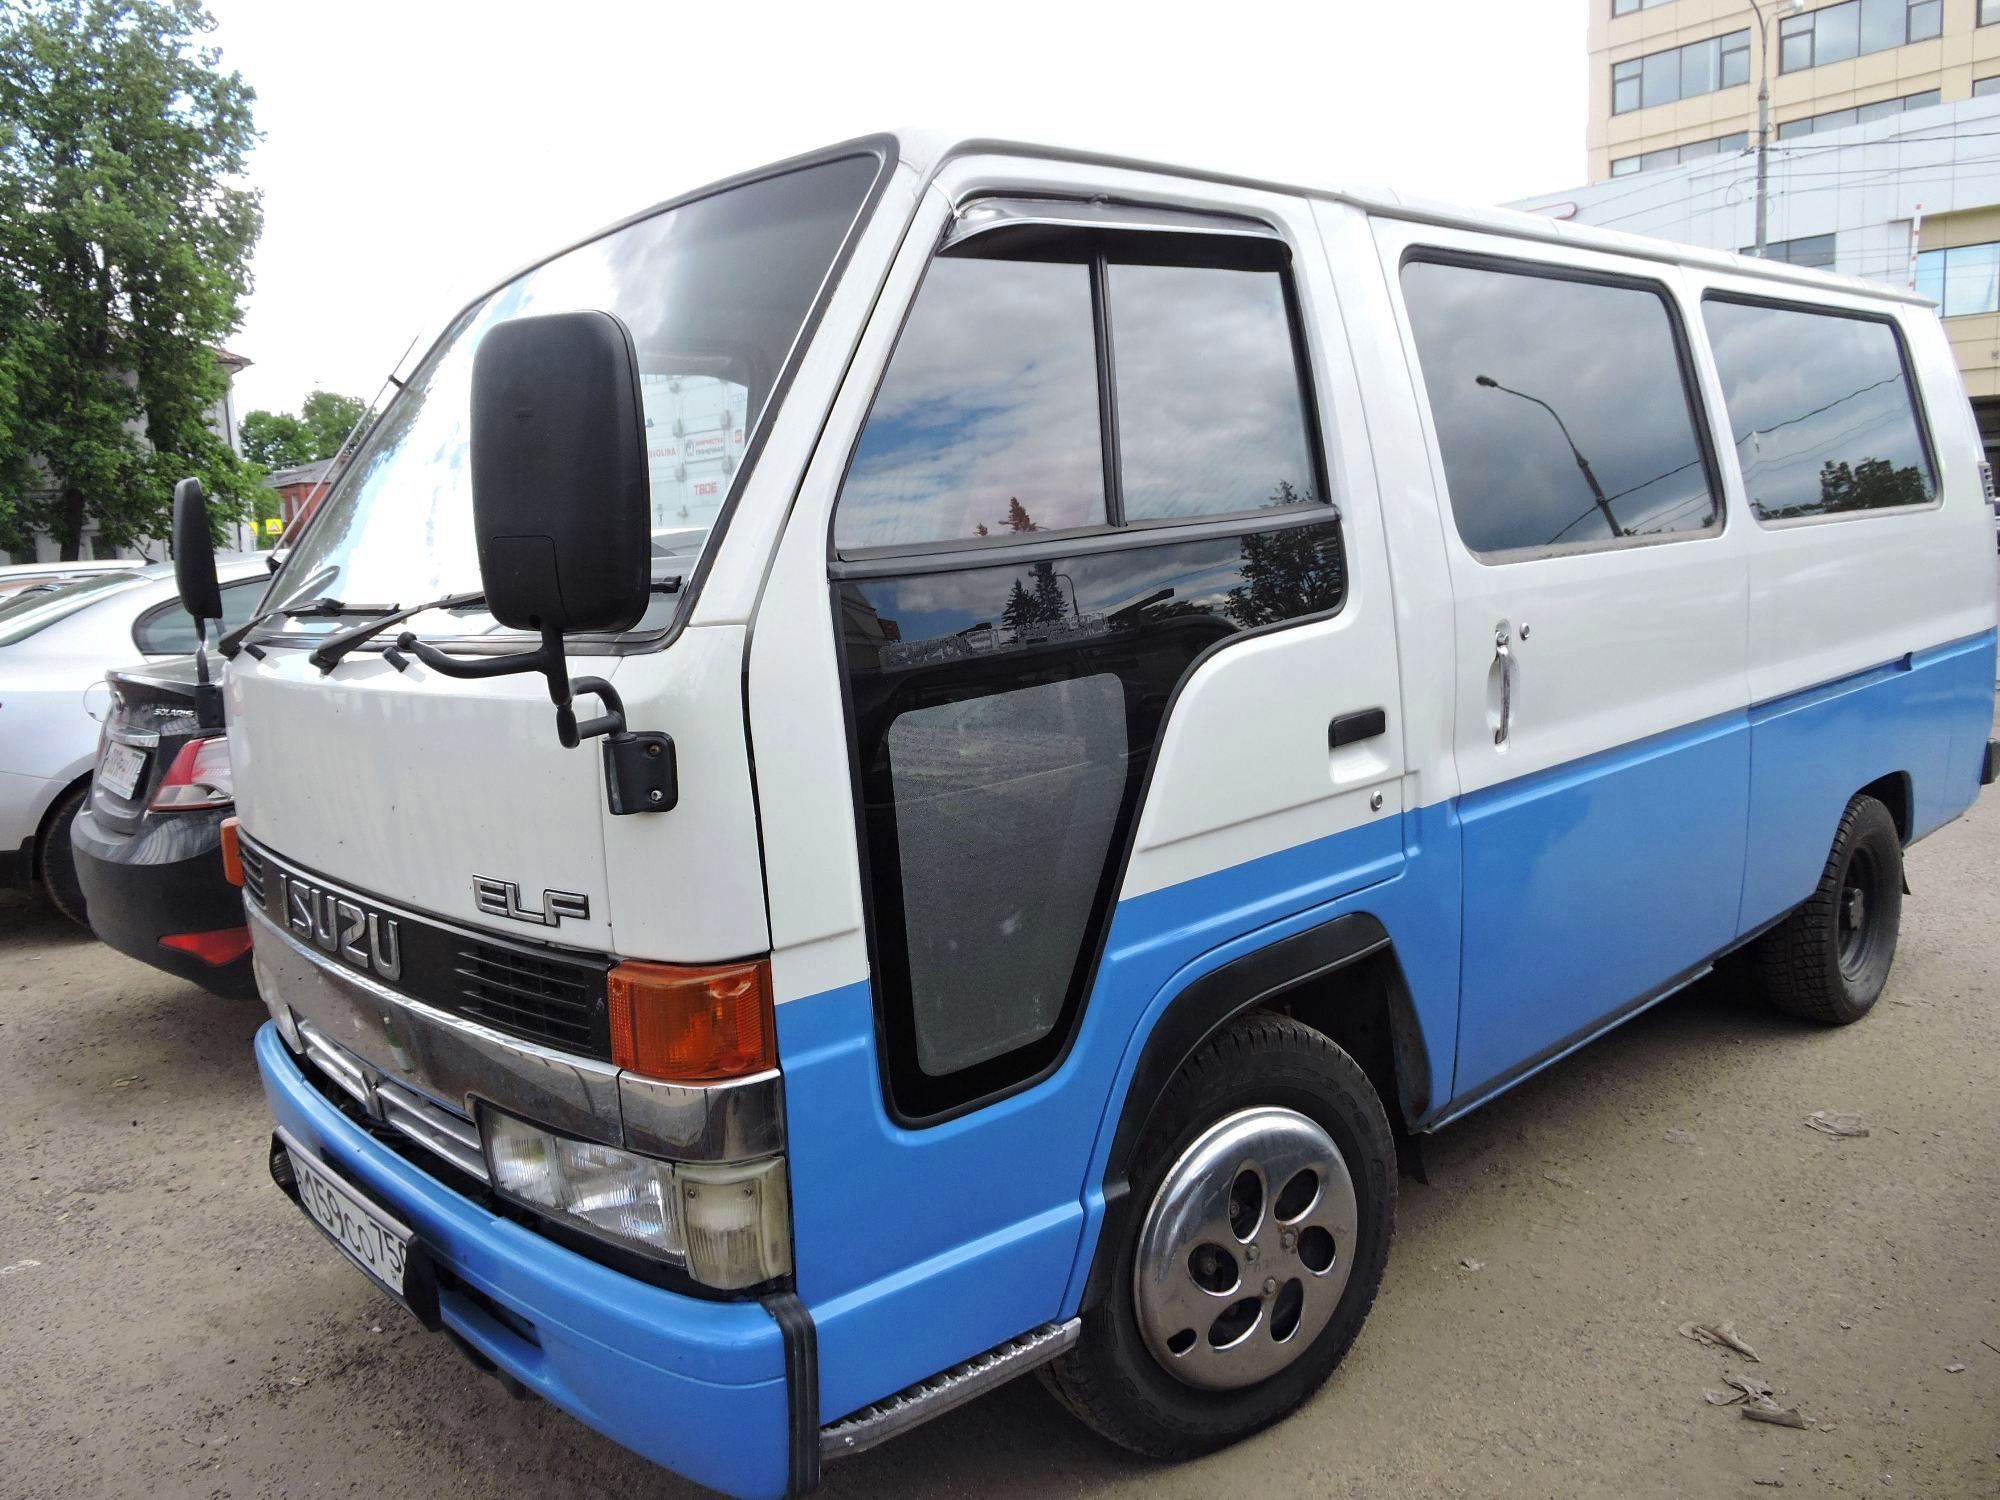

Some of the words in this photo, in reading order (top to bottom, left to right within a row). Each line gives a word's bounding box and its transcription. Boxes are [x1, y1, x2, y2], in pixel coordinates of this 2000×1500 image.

[153, 708, 196, 718] SOLARIS
[279, 873, 400, 981] ISUZU
[472, 873, 590, 928] ELF
